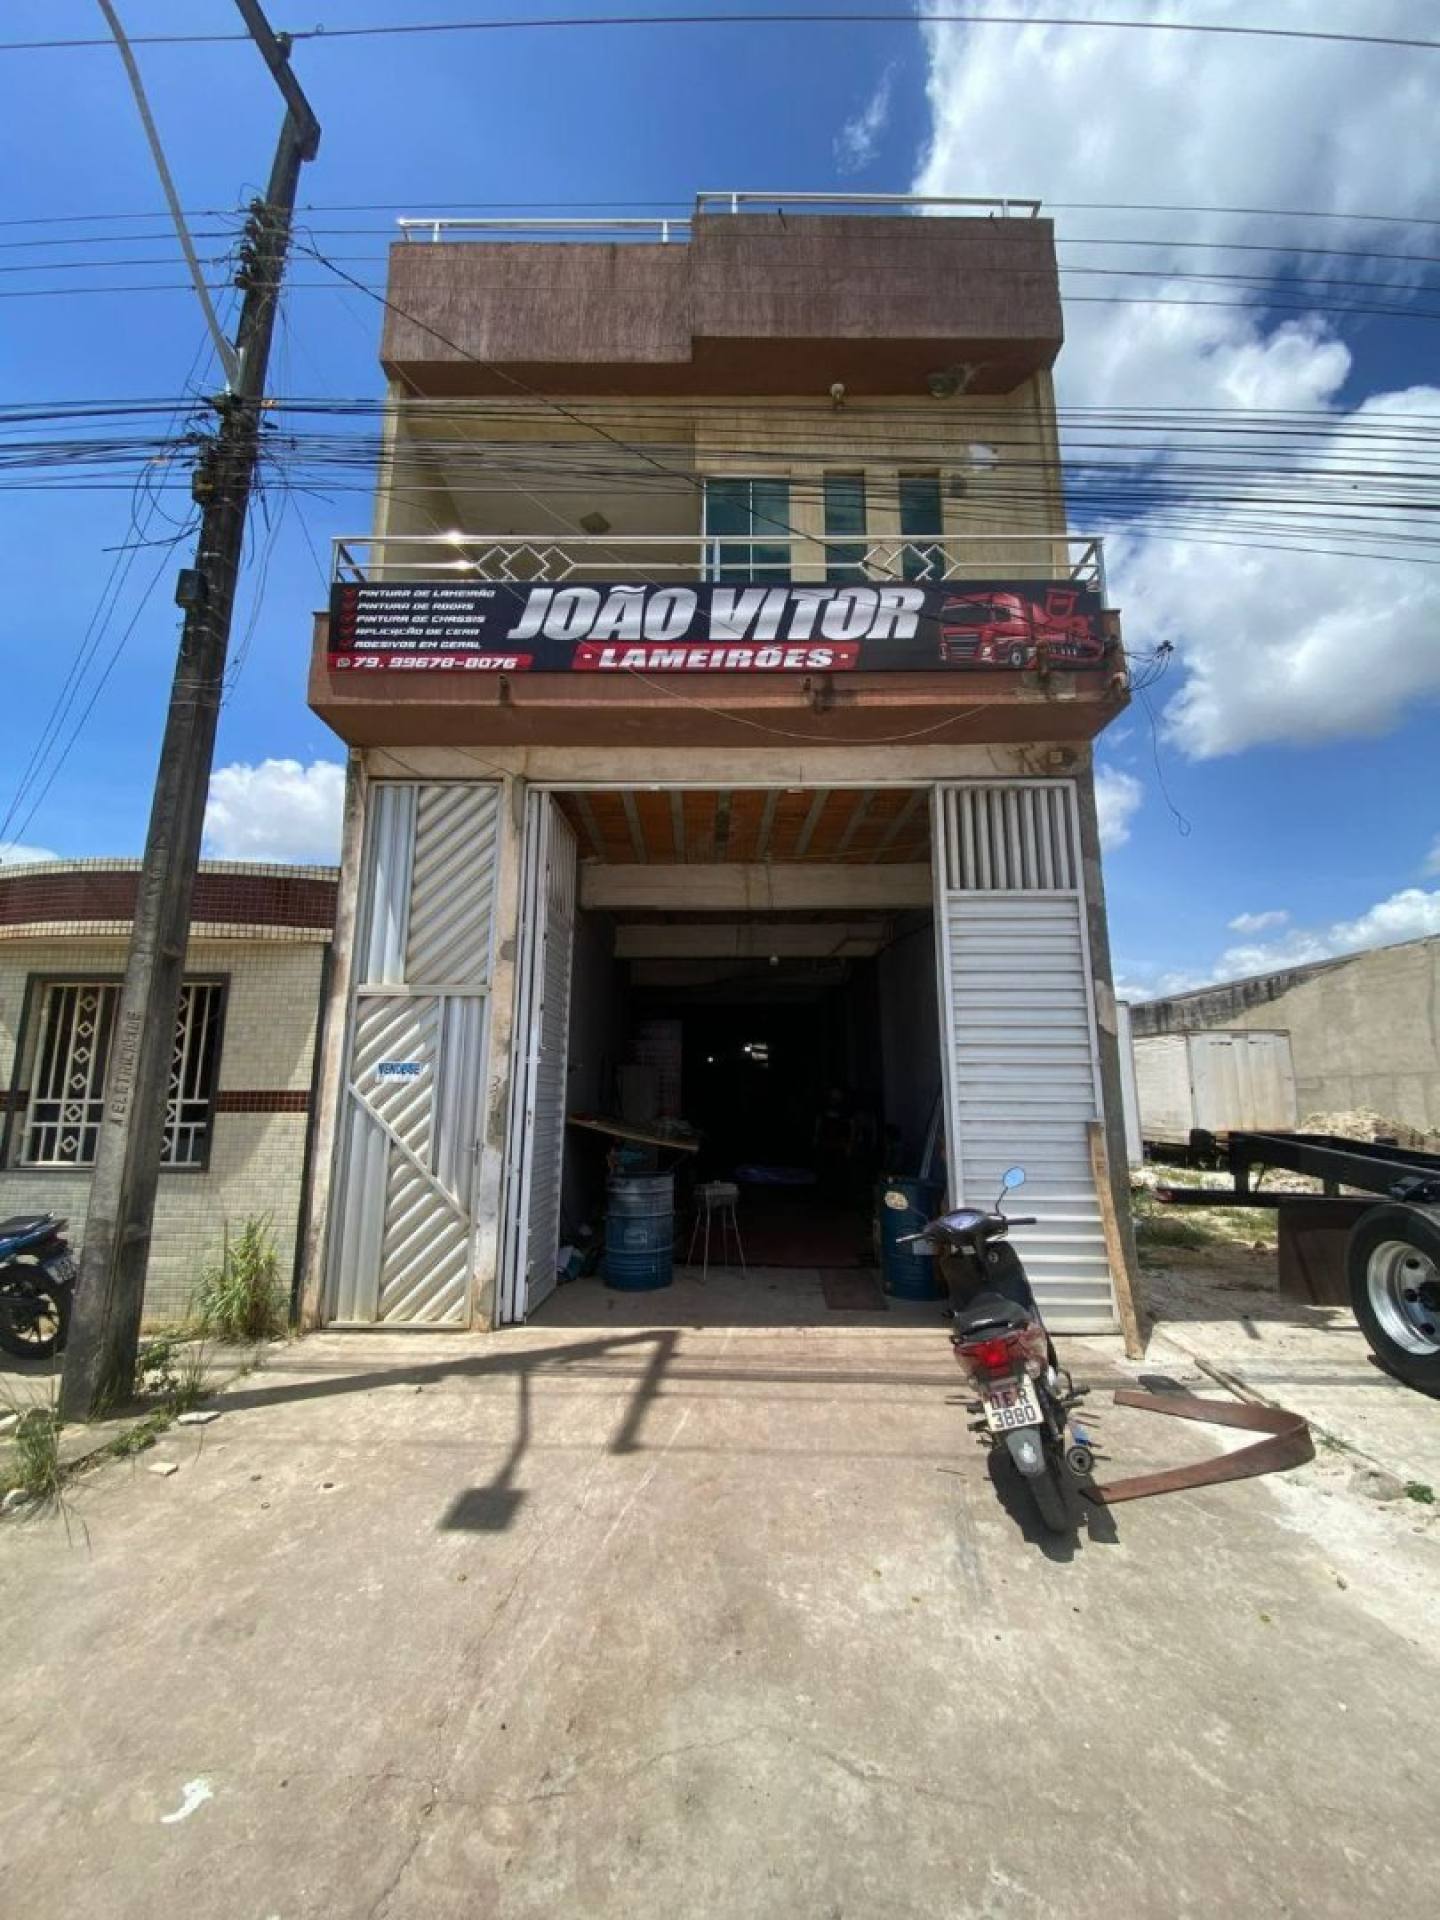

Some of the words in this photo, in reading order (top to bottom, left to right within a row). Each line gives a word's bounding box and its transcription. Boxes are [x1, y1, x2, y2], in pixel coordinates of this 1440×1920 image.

[413, 590, 430, 598] DE
[412, 603, 429, 611] DE
[507, 585, 697, 639] JOÃO
[709, 587, 926, 639] VITOR
[411, 615, 428, 623] DE
[426, 628, 442, 636] DE
[419, 641, 438, 649] EM
[599, 646, 833, 669] LAMEIRÕES
